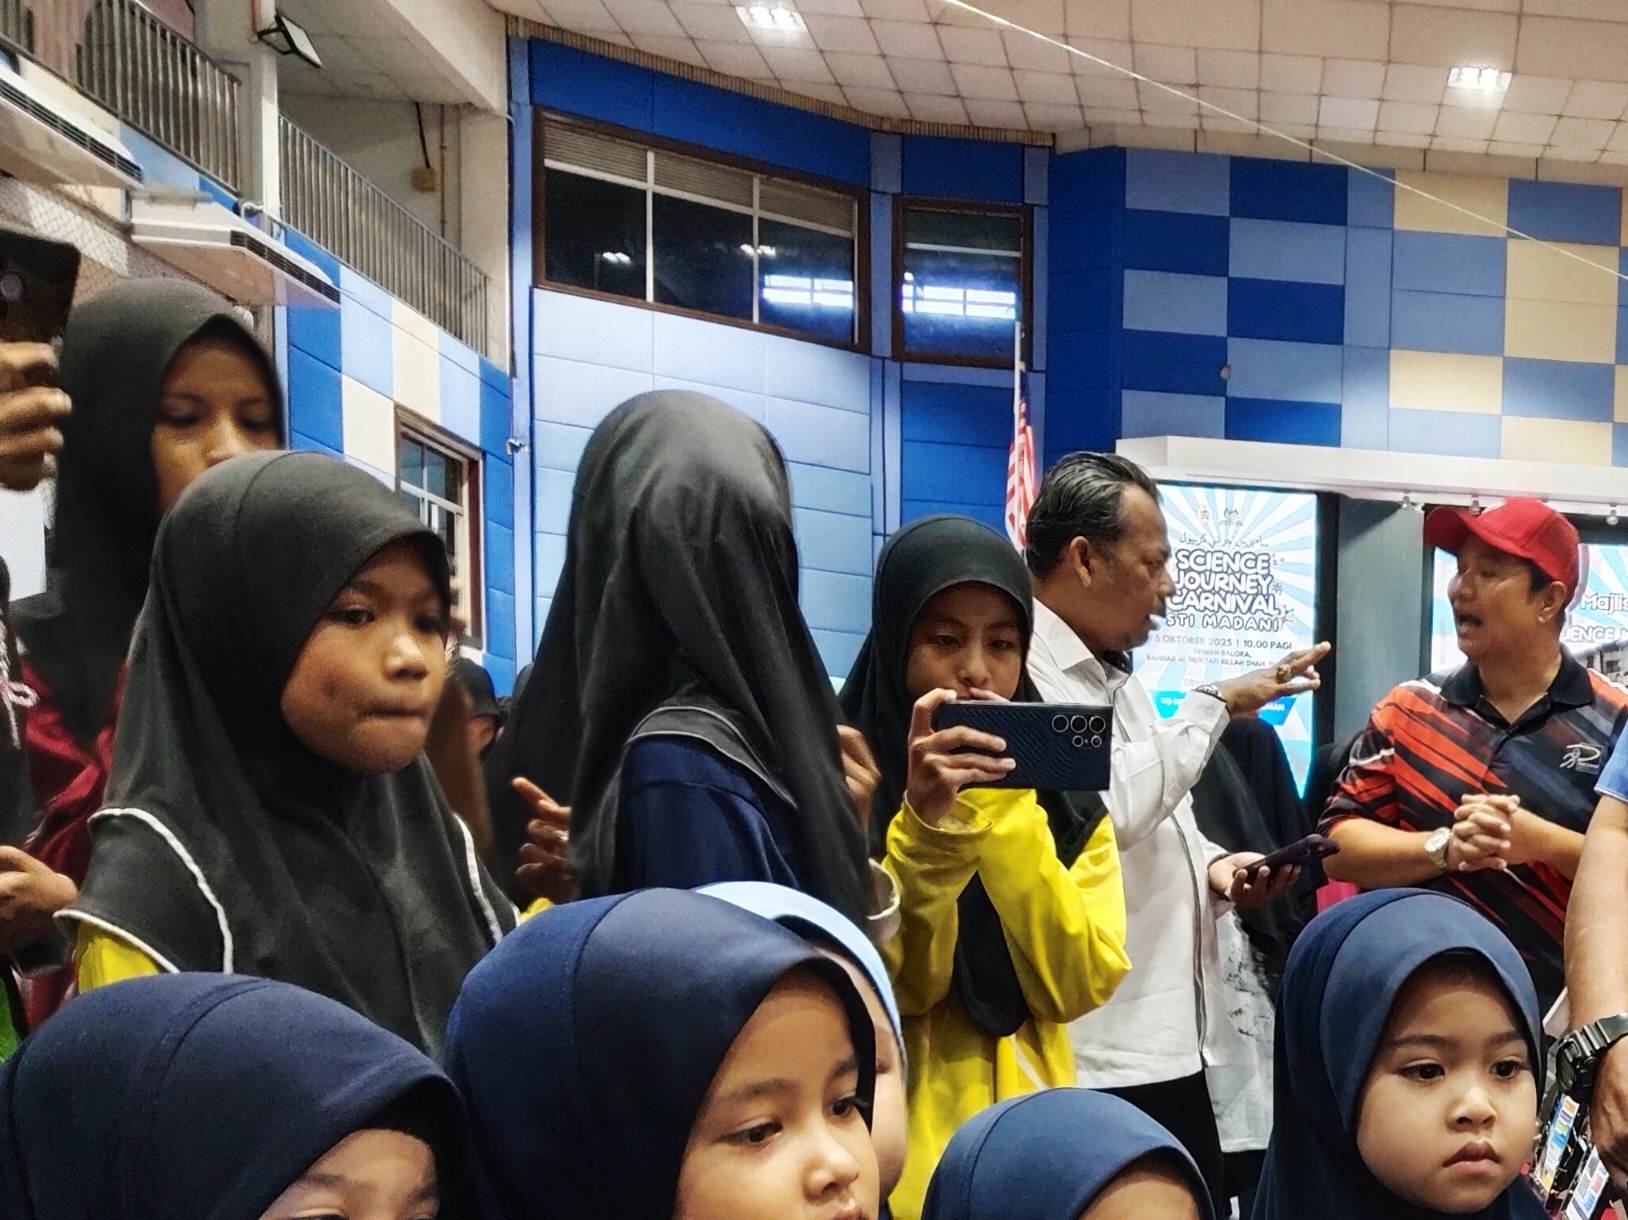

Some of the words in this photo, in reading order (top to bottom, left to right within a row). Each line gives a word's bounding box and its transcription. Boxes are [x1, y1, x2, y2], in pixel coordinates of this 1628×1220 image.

[1175, 549, 1270, 575] SCIENCE
[1174, 571, 1273, 595] JOURNEY
[1166, 589, 1281, 615] CARNIVAL
[1166, 613, 1195, 627] STI
[1202, 614, 1279, 632] MADANI
[1209, 637, 1232, 647] 2025
[1270, 640, 1292, 649] PAGI
